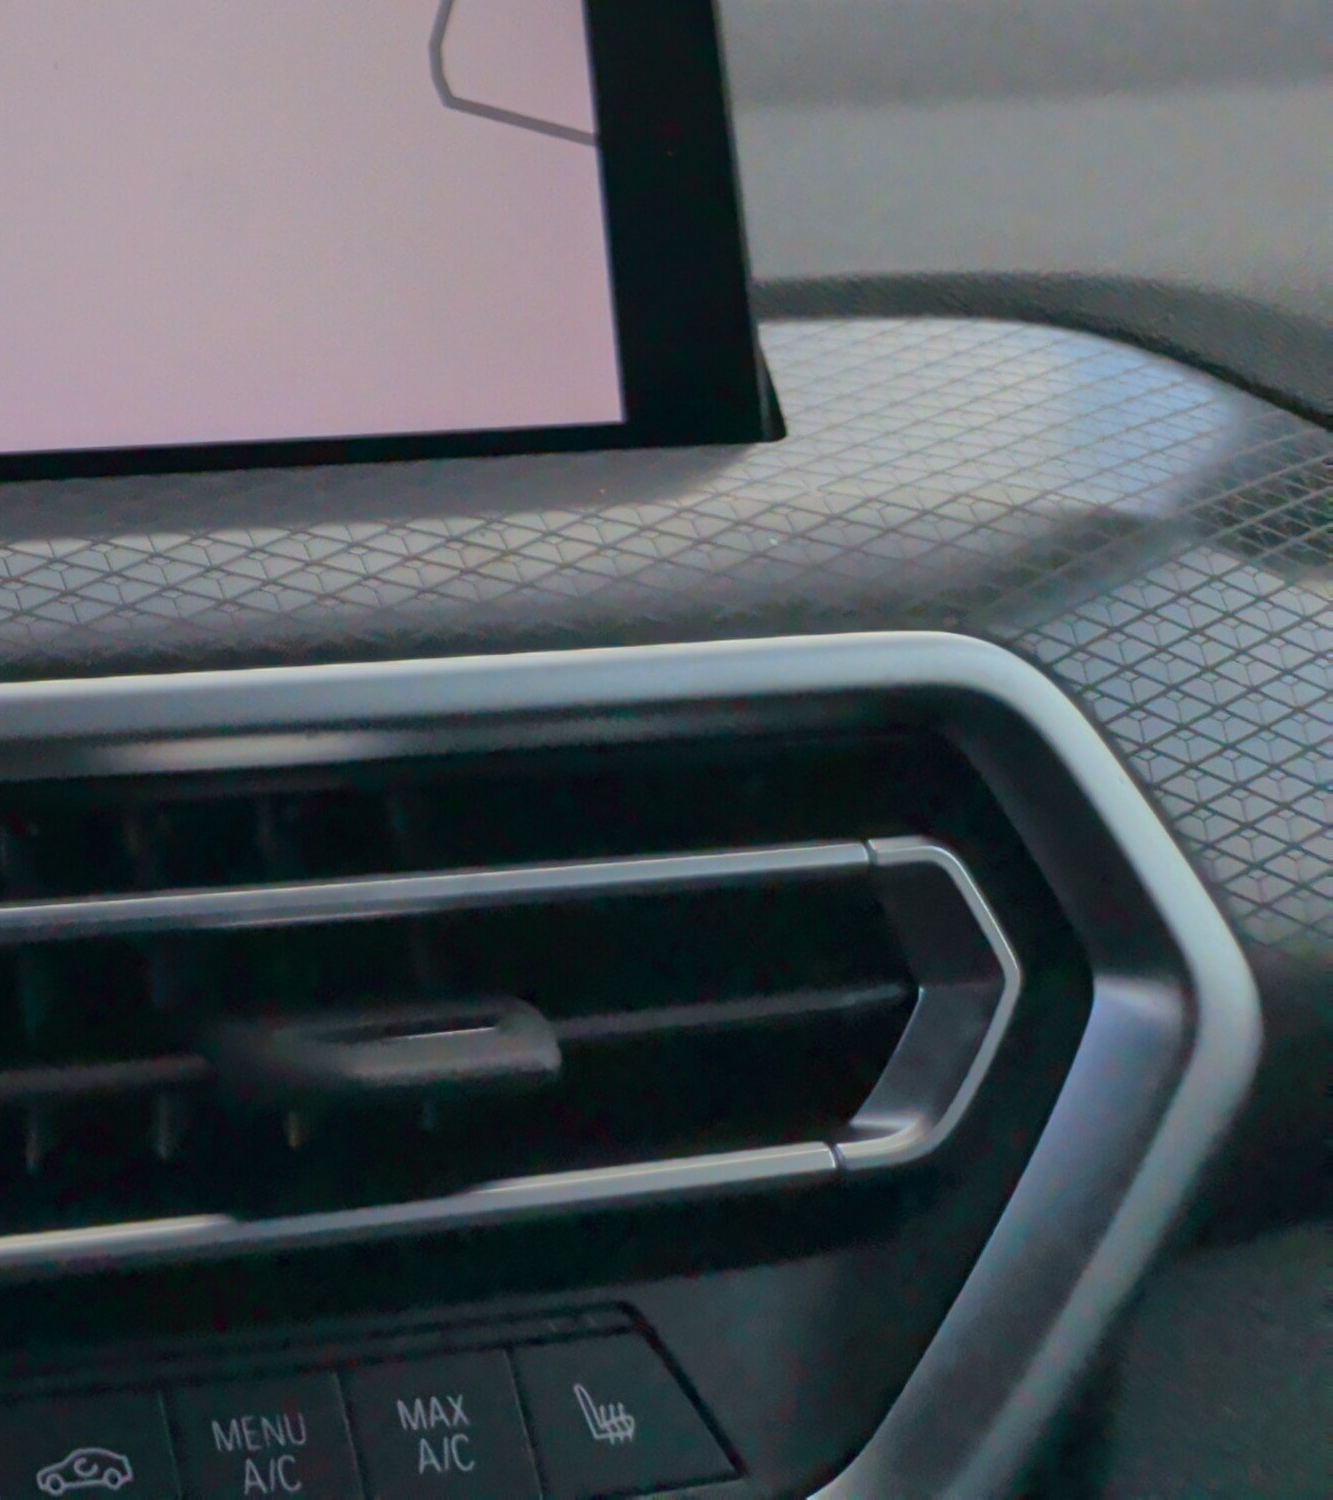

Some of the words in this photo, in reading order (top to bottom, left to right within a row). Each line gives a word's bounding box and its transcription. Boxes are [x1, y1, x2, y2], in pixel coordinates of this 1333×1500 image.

[211, 1412, 307, 1452] MENU
[396, 1394, 470, 1431] MAX
[418, 1433, 476, 1475] A/C
[244, 1454, 303, 1496] A/C
